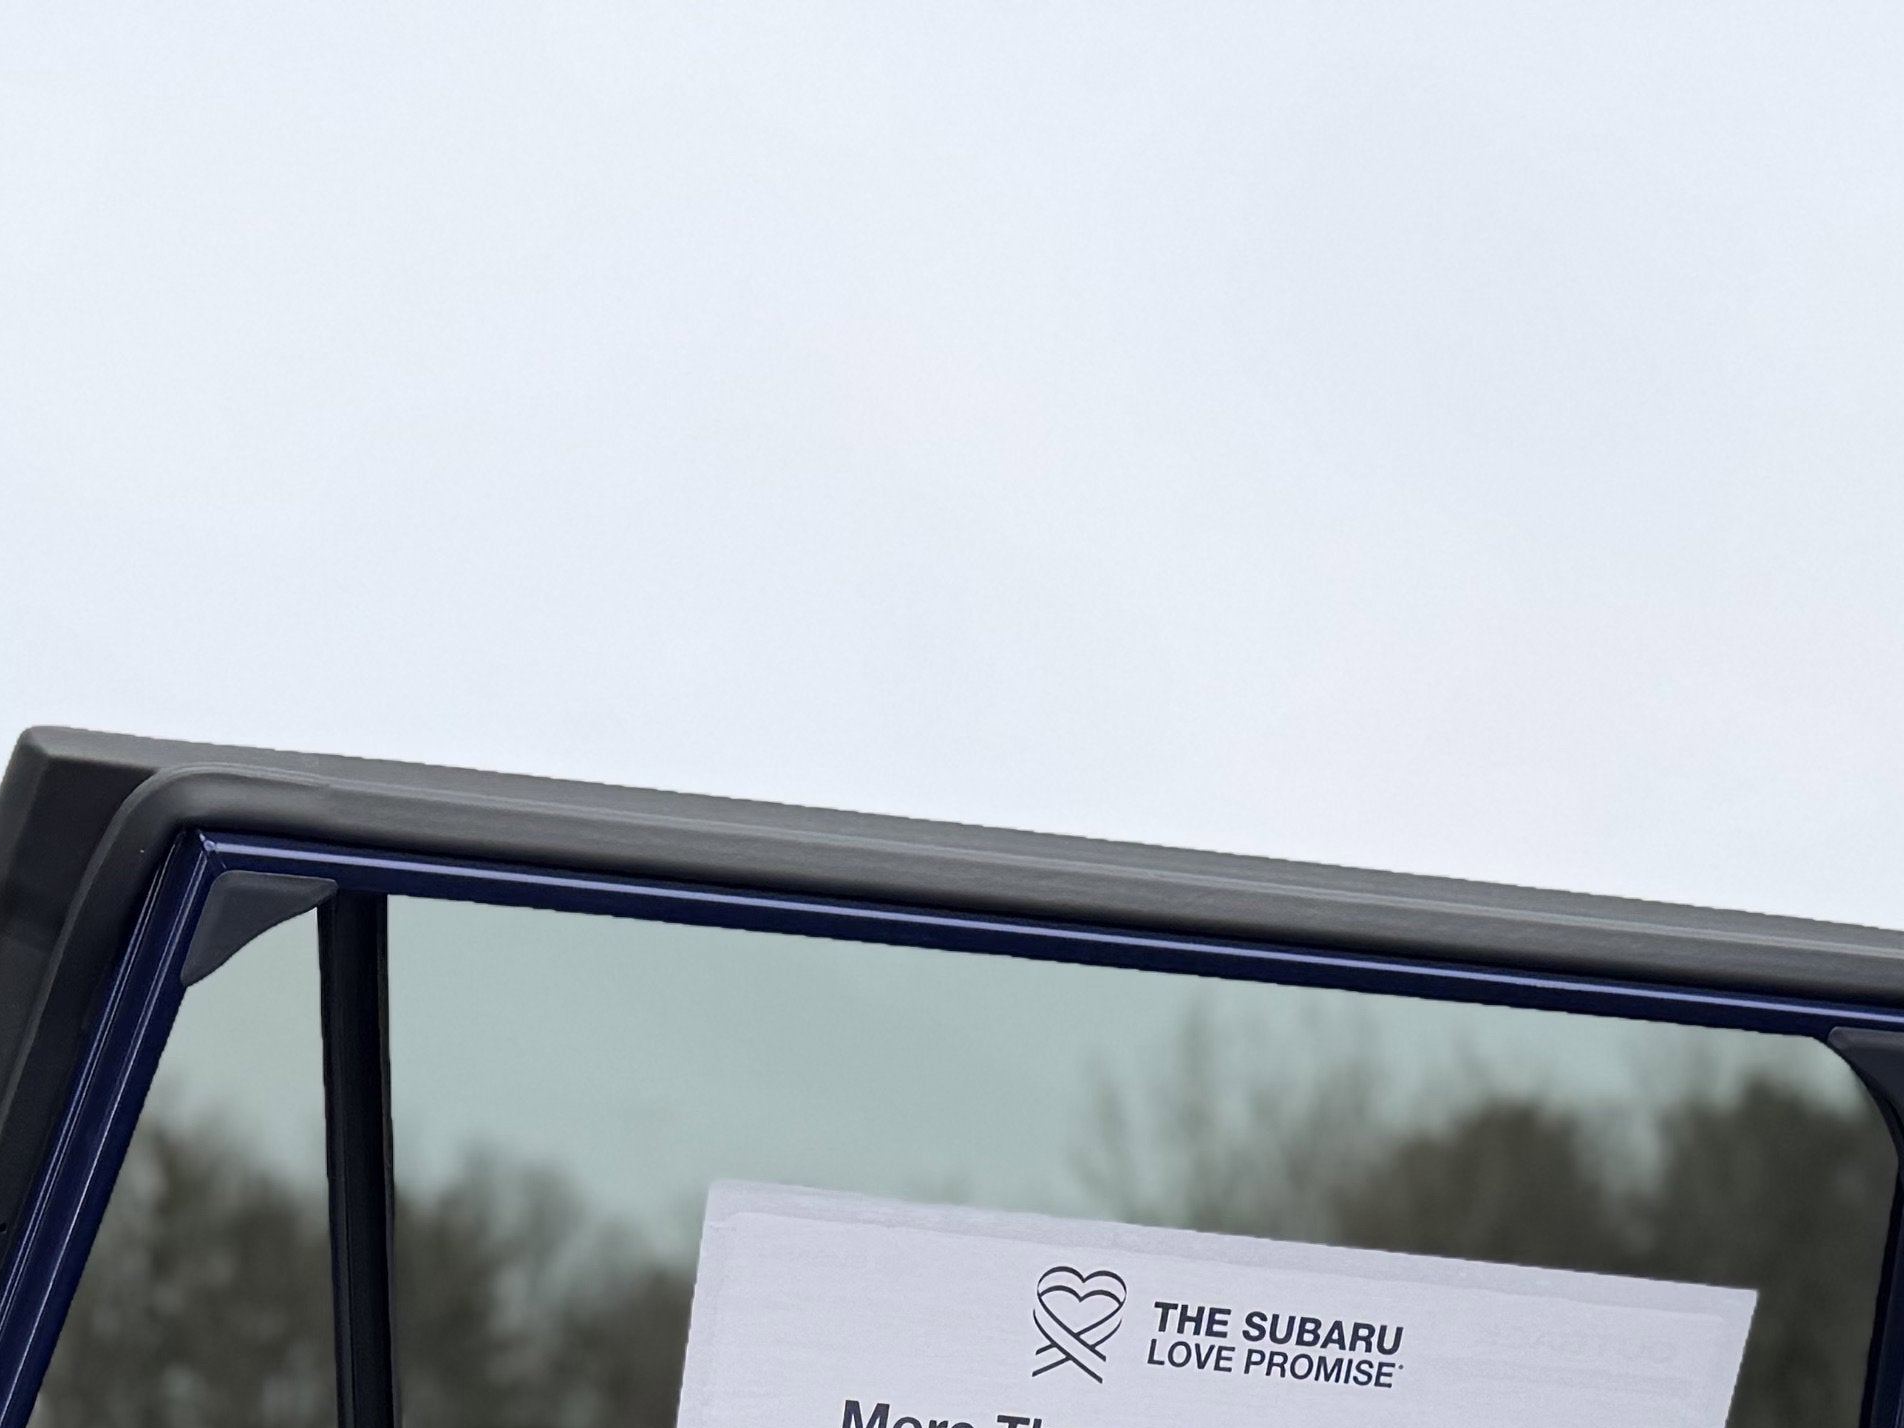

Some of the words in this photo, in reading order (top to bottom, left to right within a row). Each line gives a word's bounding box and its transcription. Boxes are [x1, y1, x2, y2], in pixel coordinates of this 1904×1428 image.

[1152, 1300, 1233, 1340] THE
[1240, 1309, 1405, 1356] SUBARU
[1145, 1337, 1237, 1374] LOVE
[1242, 1347, 1401, 1389] PROMISE
